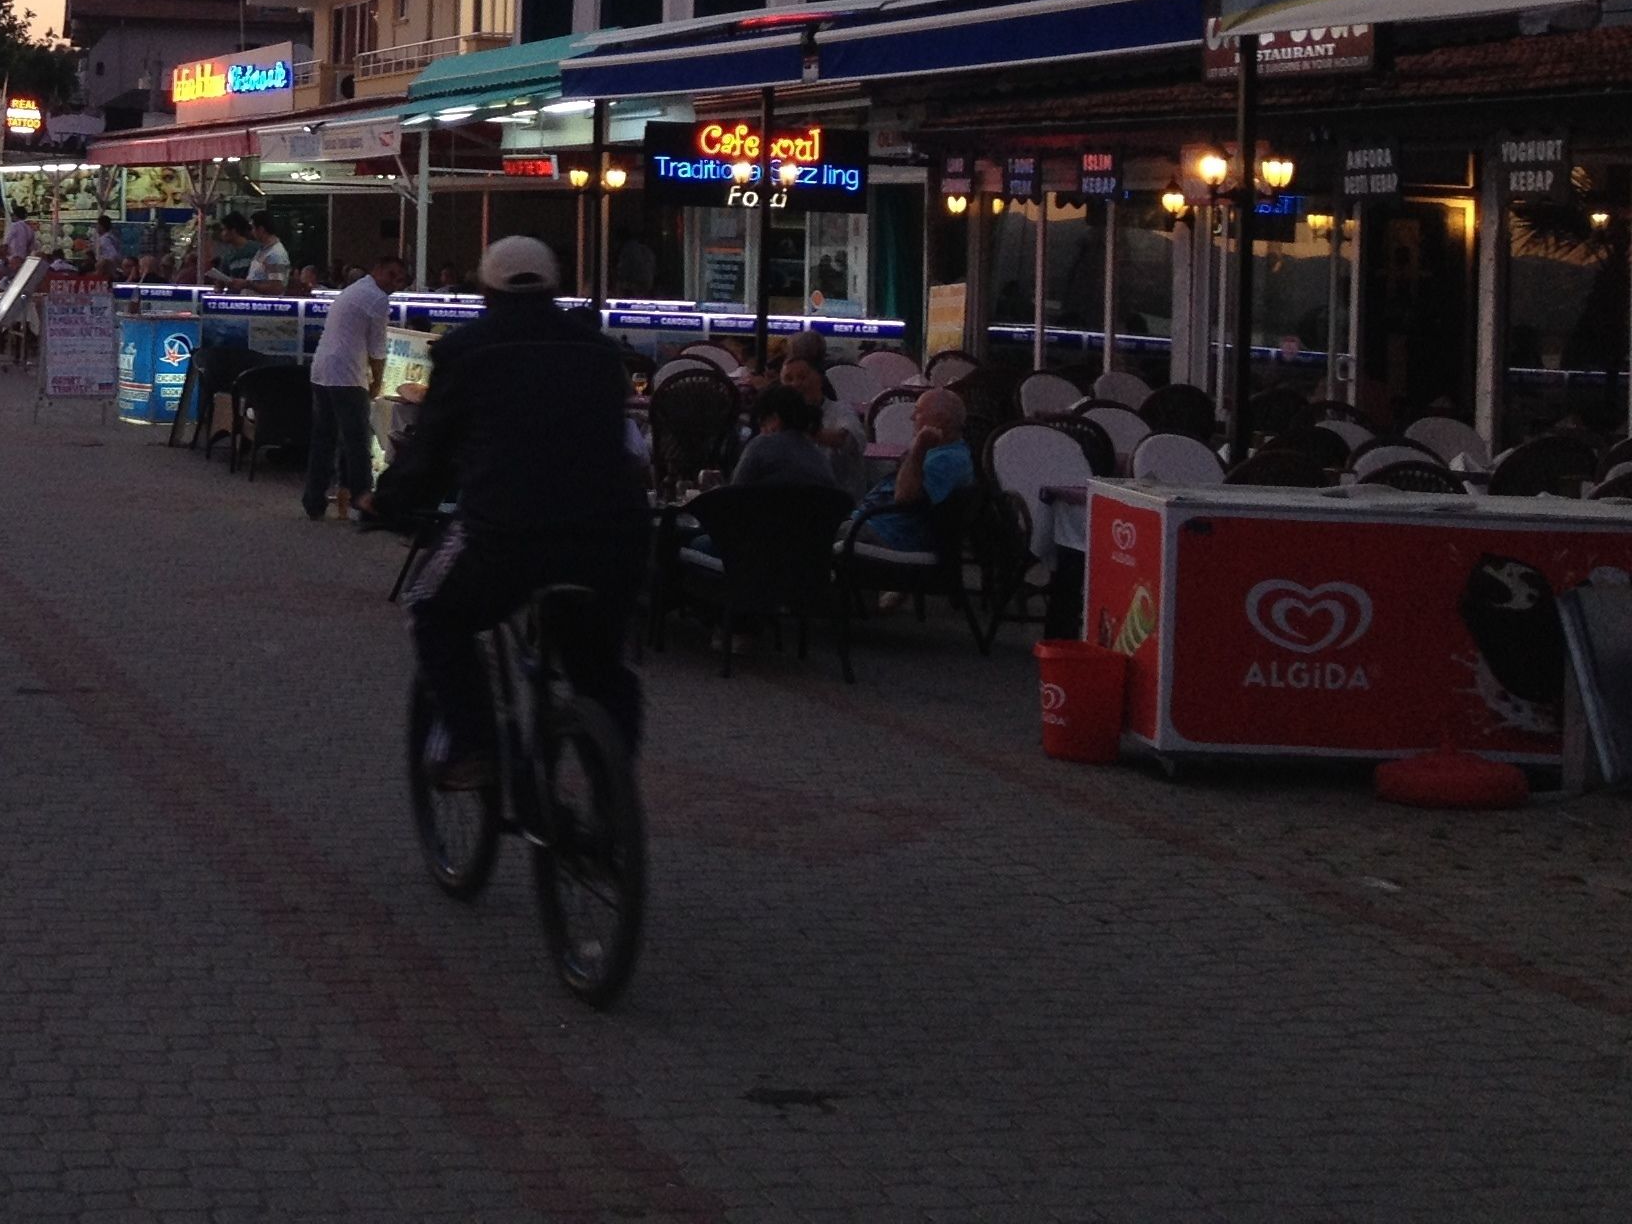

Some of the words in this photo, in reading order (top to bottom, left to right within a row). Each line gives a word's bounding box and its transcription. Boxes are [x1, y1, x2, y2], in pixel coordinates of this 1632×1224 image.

[1234, 44, 1335, 64] STAURANT
[11, 99, 38, 109] REAL
[7, 118, 41, 129] TATTOO
[700, 124, 760, 158] Cafe
[1501, 139, 1563, 163] YOGHURT
[1082, 176, 1116, 193] KEBAP
[1510, 170, 1554, 192] KEBAP
[727, 185, 788, 208] Fod
[218, 302, 250, 311] ISLANDS
[251, 303, 271, 312] BOAT
[833, 323, 854, 333] RENT
[862, 324, 879, 335] CAR
